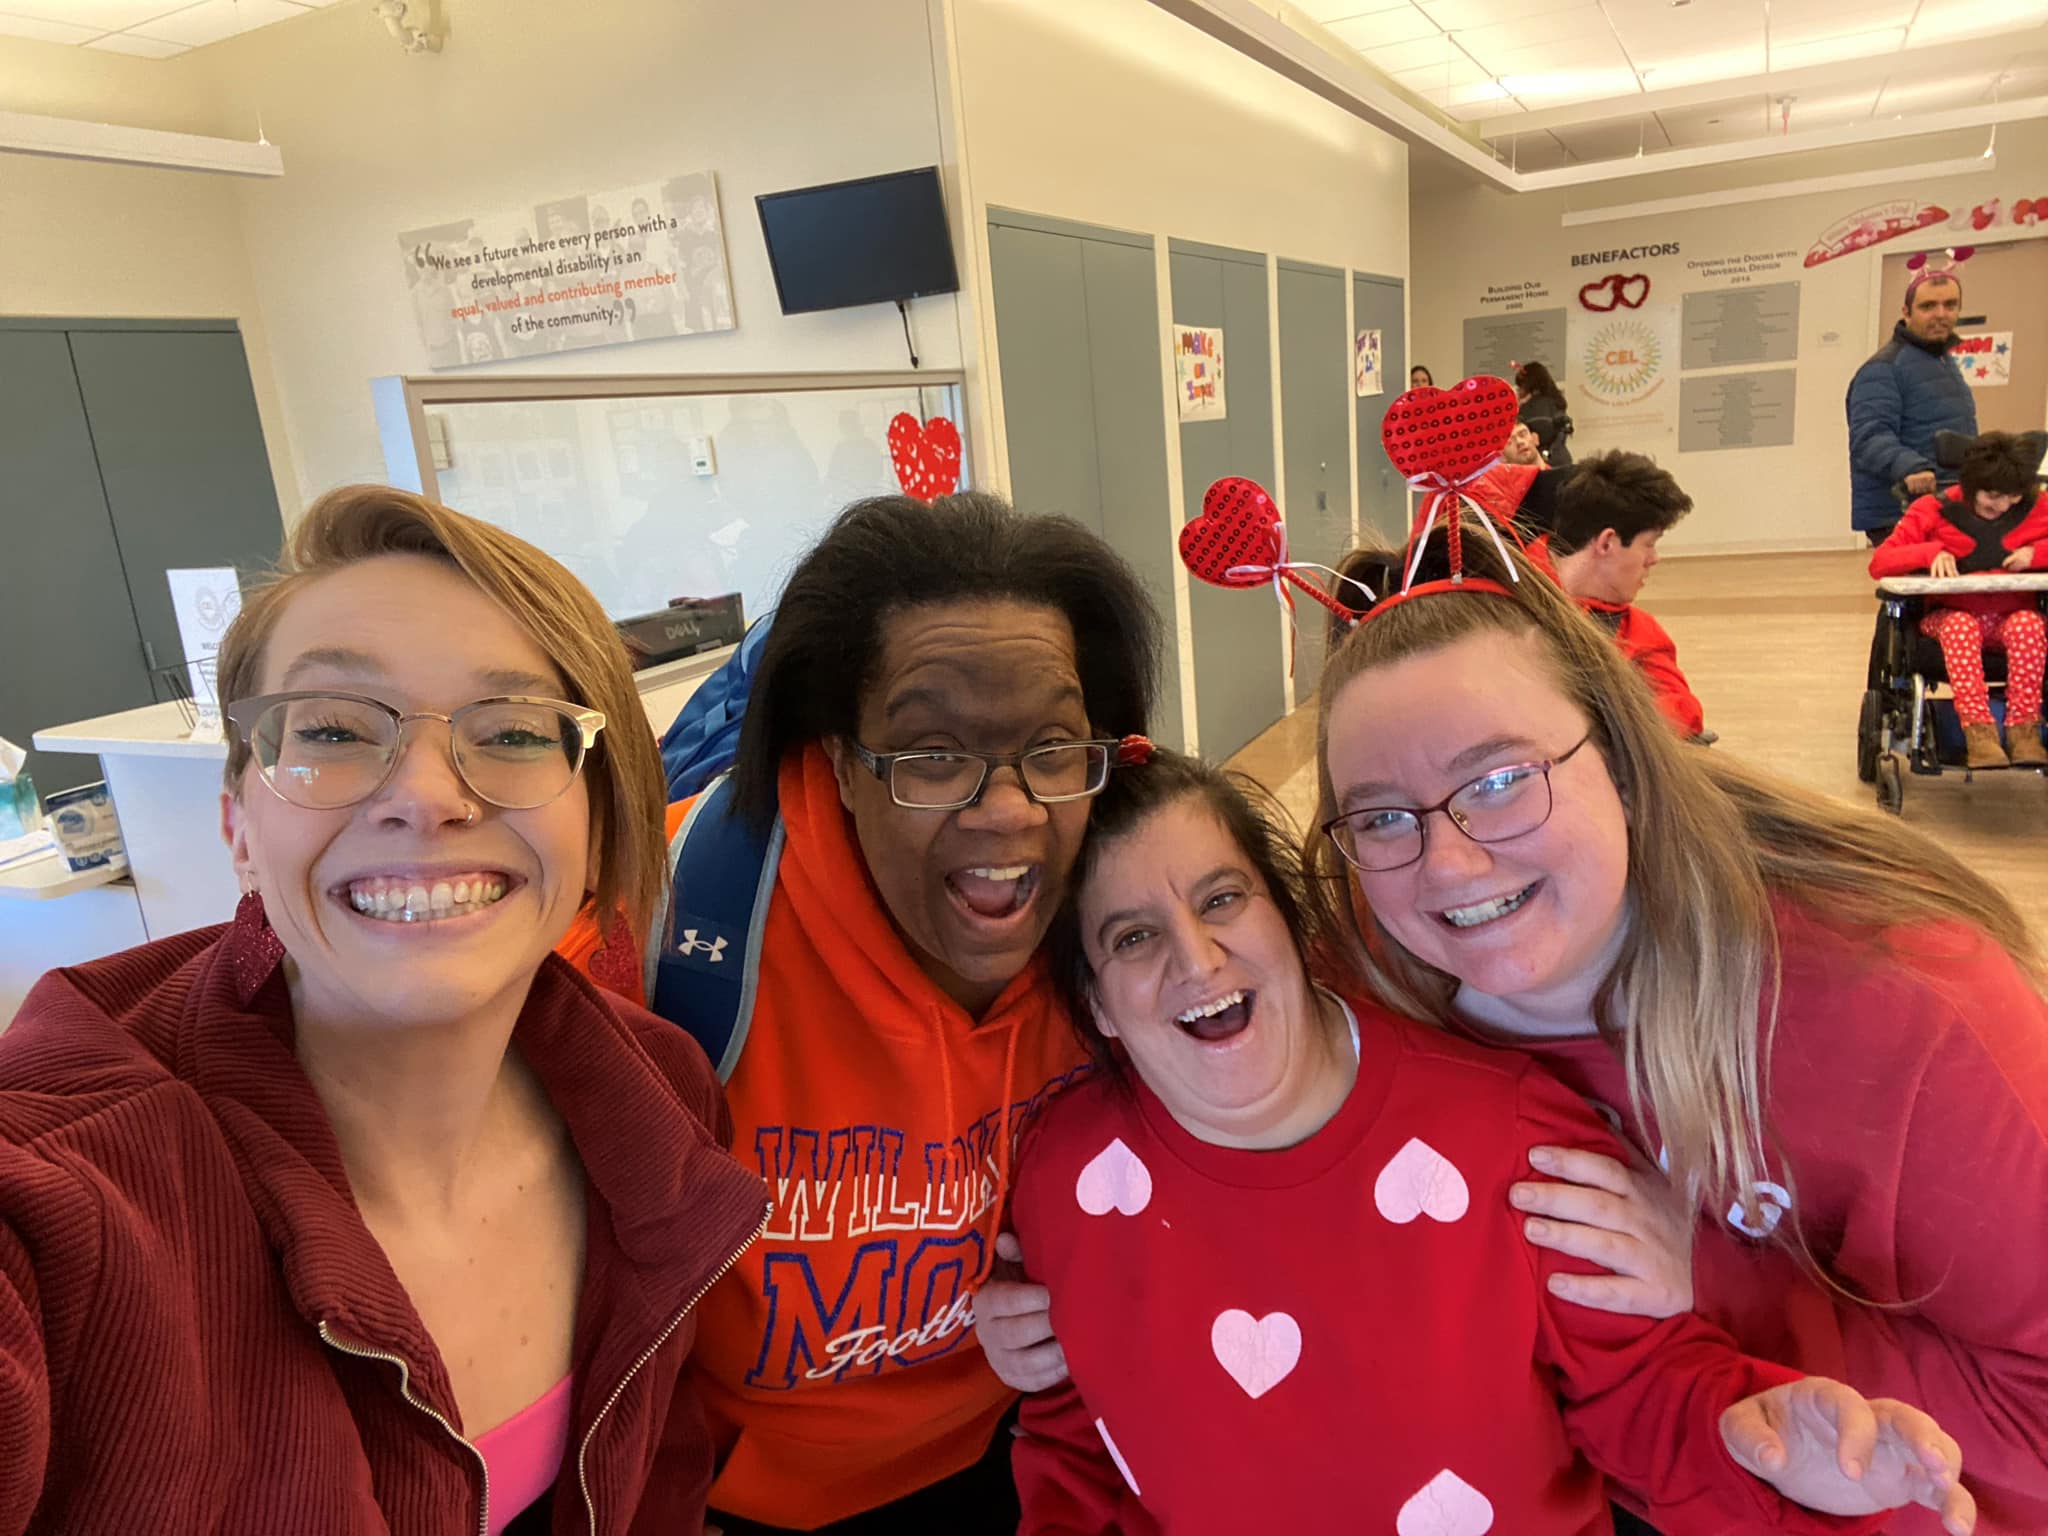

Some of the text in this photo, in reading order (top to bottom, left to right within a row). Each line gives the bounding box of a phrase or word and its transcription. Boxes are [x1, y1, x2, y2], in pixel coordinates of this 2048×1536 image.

[453, 255, 471, 268] see
[474, 254, 481, 264] a
[483, 246, 518, 262] future
[520, 238, 556, 255] where
[559, 233, 591, 249] every
[594, 225, 636, 248] person
[638, 214, 666, 233] with
[670, 217, 678, 229] a
[1570, 242, 1681, 267] BENEFACTORS
[471, 250, 641, 290] developmental disability is an
[451, 268, 677, 320] equal, valued and contributing member
[511, 316, 522, 333] of
[525, 314, 544, 331] the
[1605, 350, 1638, 366] CEL
[664, 620, 700, 640] DELL
[744, 1229, 986, 1391] MO
